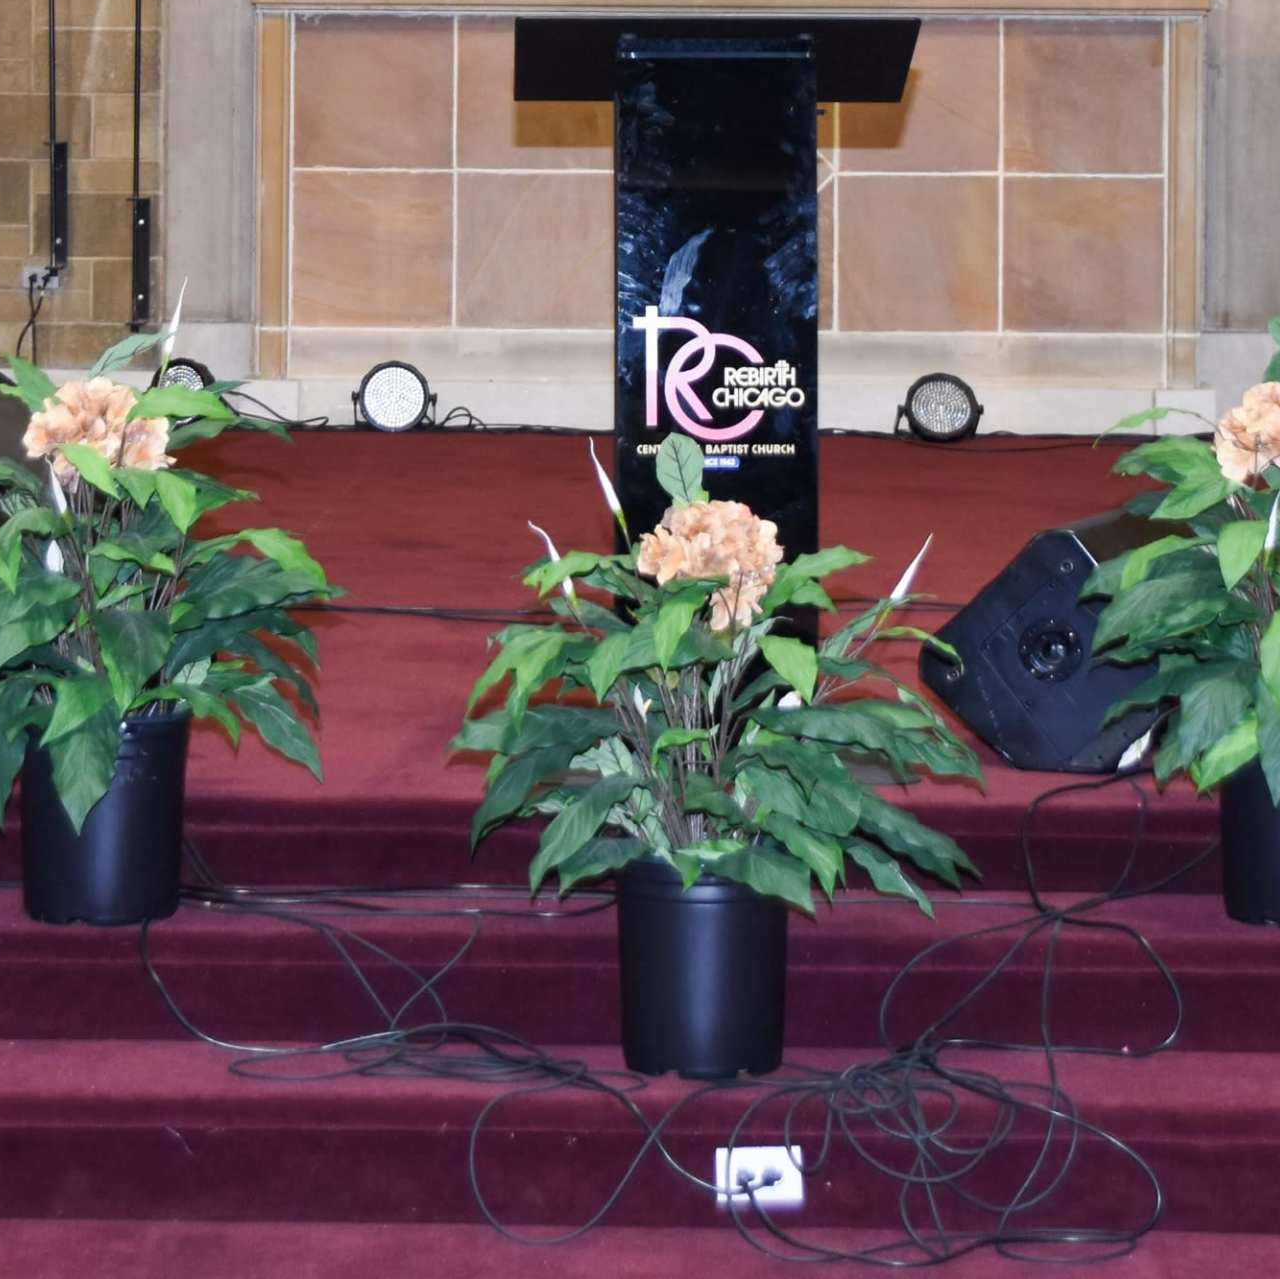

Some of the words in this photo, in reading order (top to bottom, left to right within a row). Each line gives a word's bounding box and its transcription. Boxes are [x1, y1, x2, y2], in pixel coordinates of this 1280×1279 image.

[724, 360, 796, 387] REBIRTH
[712, 387, 805, 408] CHICAGO
[705, 443, 749, 455] BAPTIST
[751, 443, 795, 455] CHURCH
